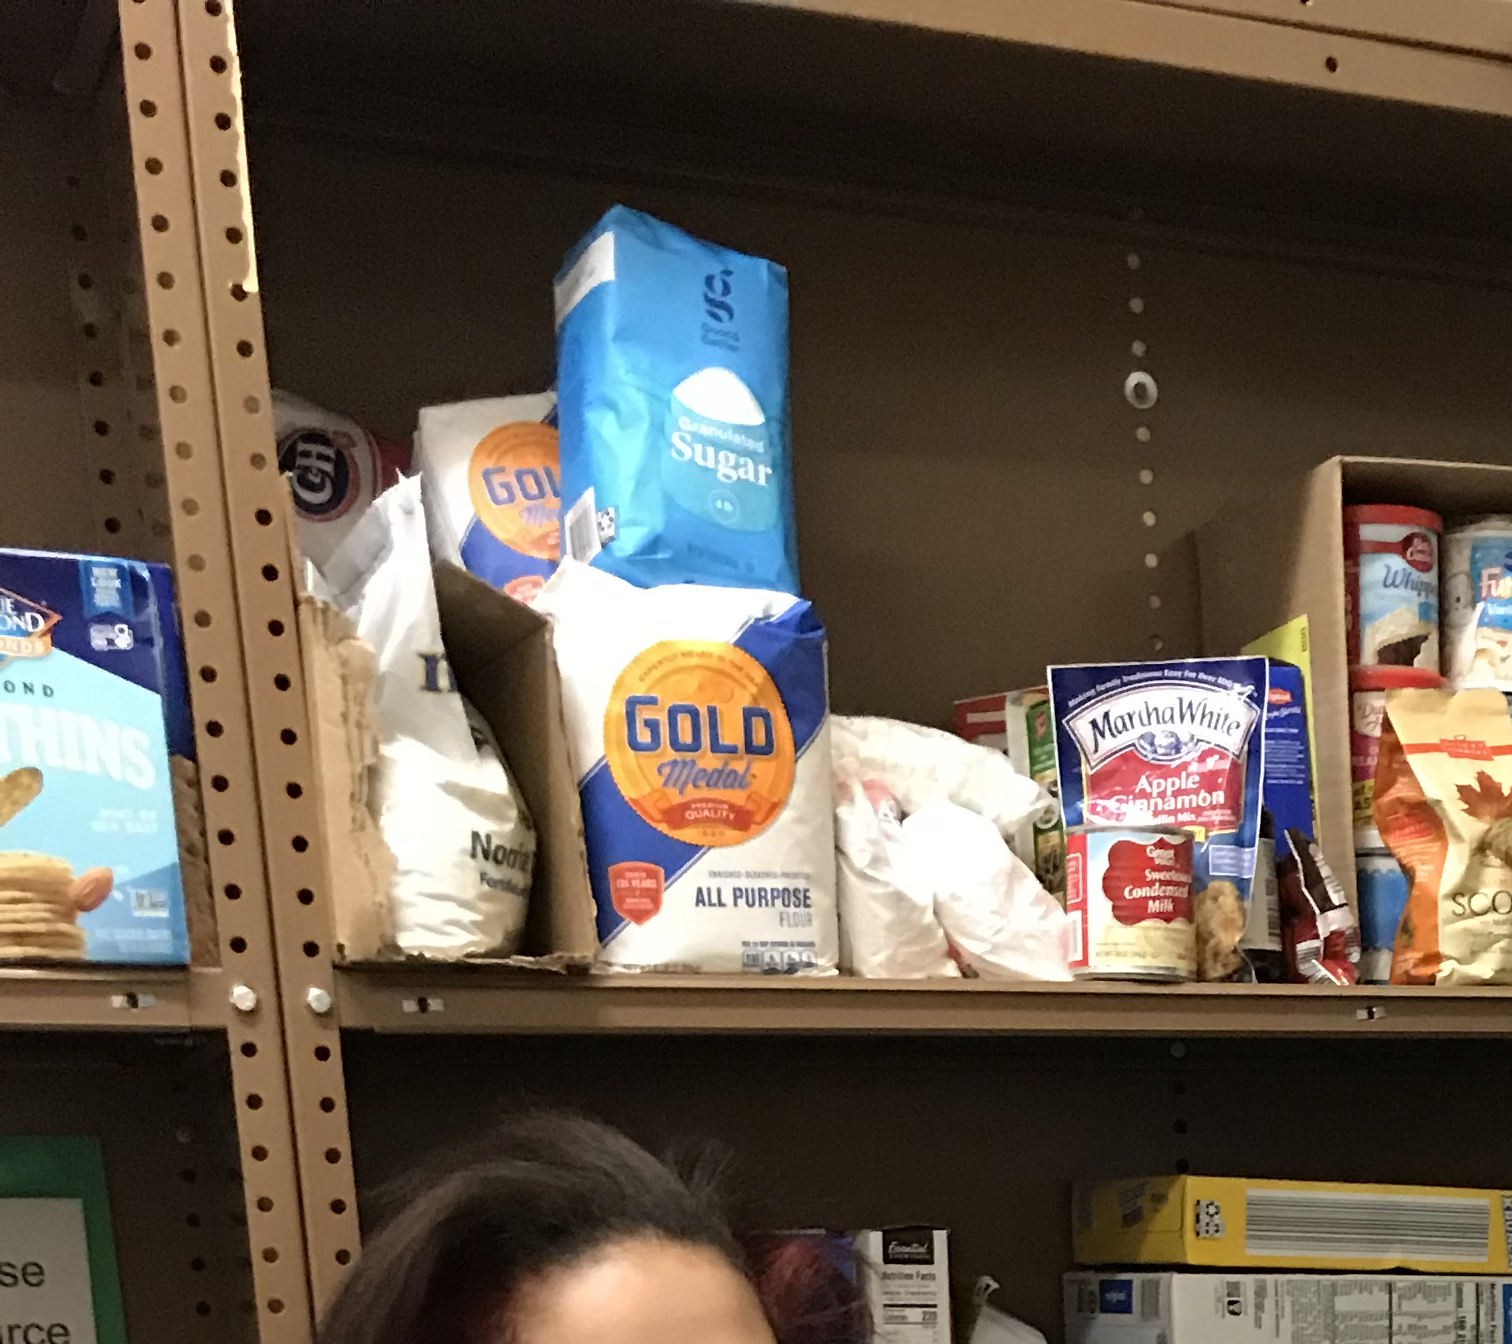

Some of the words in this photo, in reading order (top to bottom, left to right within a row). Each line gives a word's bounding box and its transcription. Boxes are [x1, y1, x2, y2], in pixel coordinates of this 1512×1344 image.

[678, 416, 765, 453] Granulated
[671, 431, 772, 486] Sugar
[481, 460, 560, 506] GOL
[625, 695, 776, 756] GOLD
[1090, 700, 1175, 754] Martha
[1176, 696, 1242, 738] White
[657, 757, 753, 796] Medal
[1135, 771, 1200, 798] Apple
[1112, 789, 1225, 814] Cinnamon
[685, 808, 737, 822] QUALITY
[1177, 812, 1197, 823] Mix
[695, 886, 727, 908] ALL
[733, 886, 812, 910] PURPOSE
[1123, 883, 1190, 900] Condensed
[1147, 899, 1175, 913] Milk
[779, 911, 813, 928] FLOUR
